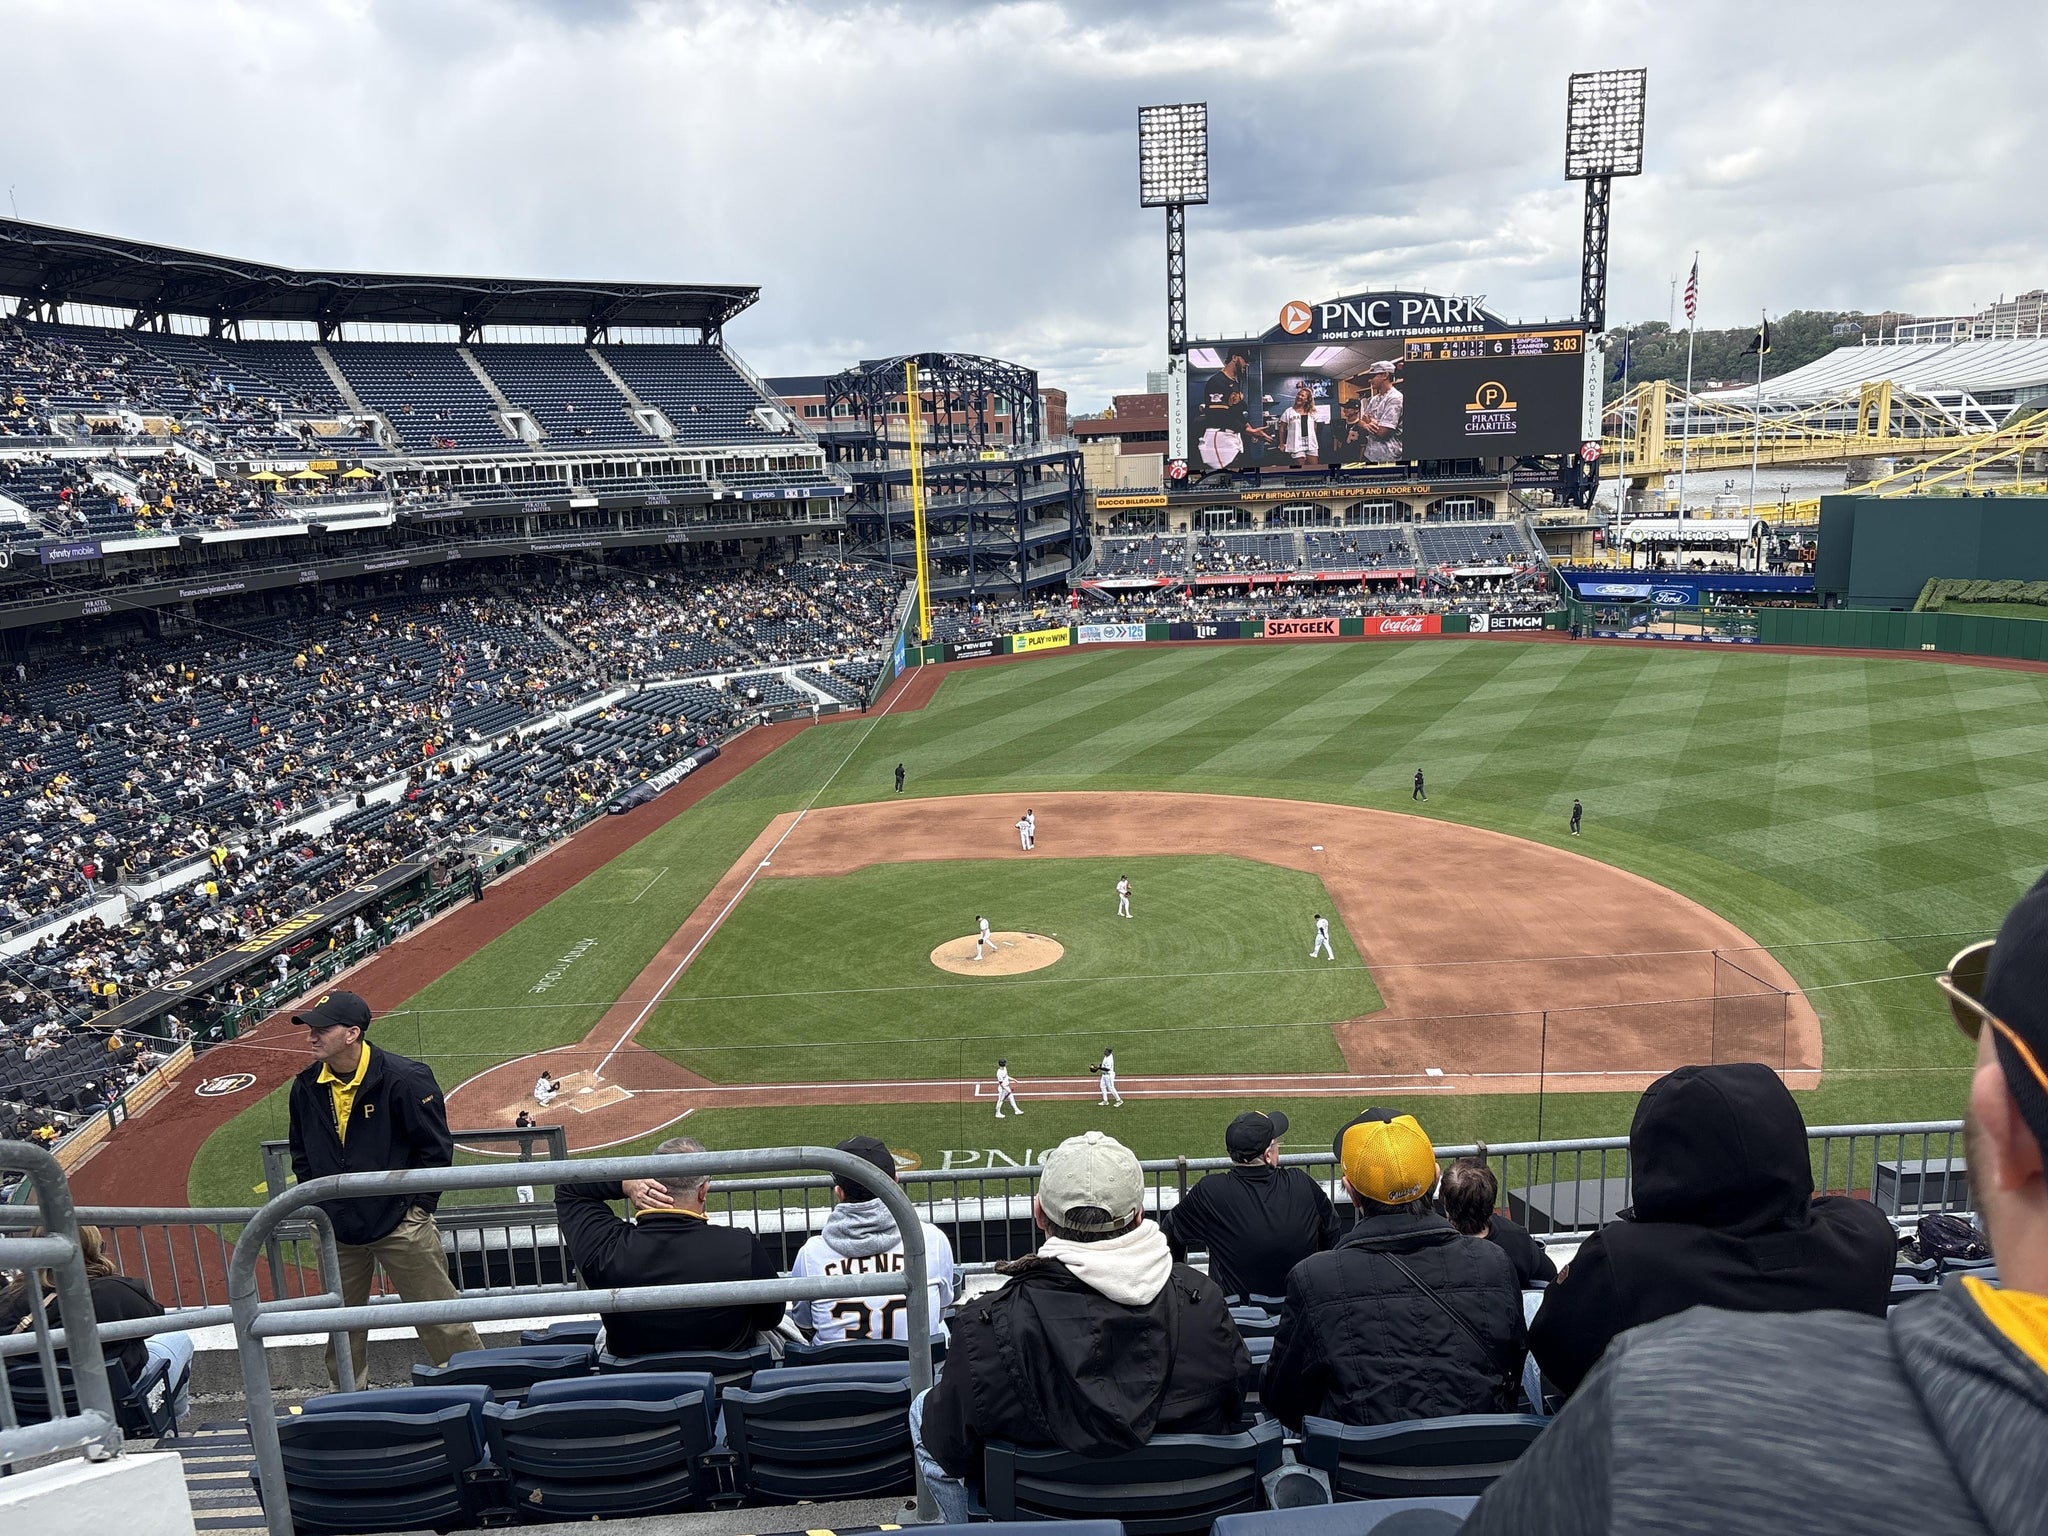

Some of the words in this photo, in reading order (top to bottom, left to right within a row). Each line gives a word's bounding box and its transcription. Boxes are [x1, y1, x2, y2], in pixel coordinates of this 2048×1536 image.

[1319, 300, 1391, 330] PNC
[1399, 294, 1487, 326] PARK
[1322, 332, 1349, 341] HOME
[1351, 331, 1363, 339] OF
[1365, 330, 1384, 338] THE
[1386, 326, 1443, 337] PITTSBURGH
[1446, 325, 1484, 334] PIRATES
[1494, 342, 1503, 353] 6
[1553, 338, 1577, 351] 3:03
[1588, 378, 1597, 398] MOR
[1486, 389, 1498, 405] P
[1175, 410, 1182, 425] GO
[1472, 413, 1511, 423] PIRATES
[1465, 421, 1517, 431] CHARITIES
[250, 462, 264, 472] CITY
[265, 462, 274, 472] OF
[274, 461, 310, 472] CHAMPIONS
[752, 492, 776, 500] KOPPERS
[1241, 492, 1265, 500] HAPPY
[1266, 490, 1301, 499] BIRTHDAY
[1302, 490, 1331, 498] TAYLOR!
[1412, 486, 1430, 494] YOU!
[1648, 531, 1672, 541] FAT
[1676, 530, 1730, 541] HEAD'S
[530, 541, 602, 550] Pirates.com/piratescharities
[48, 548, 71, 560] xfinity
[72, 546, 95, 556] mobile
[179, 582, 246, 598] Pirates.com/piratescharities
[84, 600, 108, 608] PIRATES
[1656, 592, 1682, 604] Ford
[82, 606, 112, 615] CHARITIES
[1268, 620, 1335, 636] SEATGEEK
[1380, 618, 1425, 633] Coca-Cola
[1490, 616, 1543, 628] BETMGM
[1126, 626, 1144, 638] 125
[1196, 626, 1218, 639] Lite
[1028, 636, 1044, 646] PLAY
[1052, 633, 1068, 643] WIN!
[646, 766, 684, 792] Chicken
[236, 914, 325, 952] PIRATES
[558, 937, 598, 963] xfinity
[528, 964, 570, 994] mobile
[314, 996, 330, 1008] P
[364, 1104, 374, 1119] P
